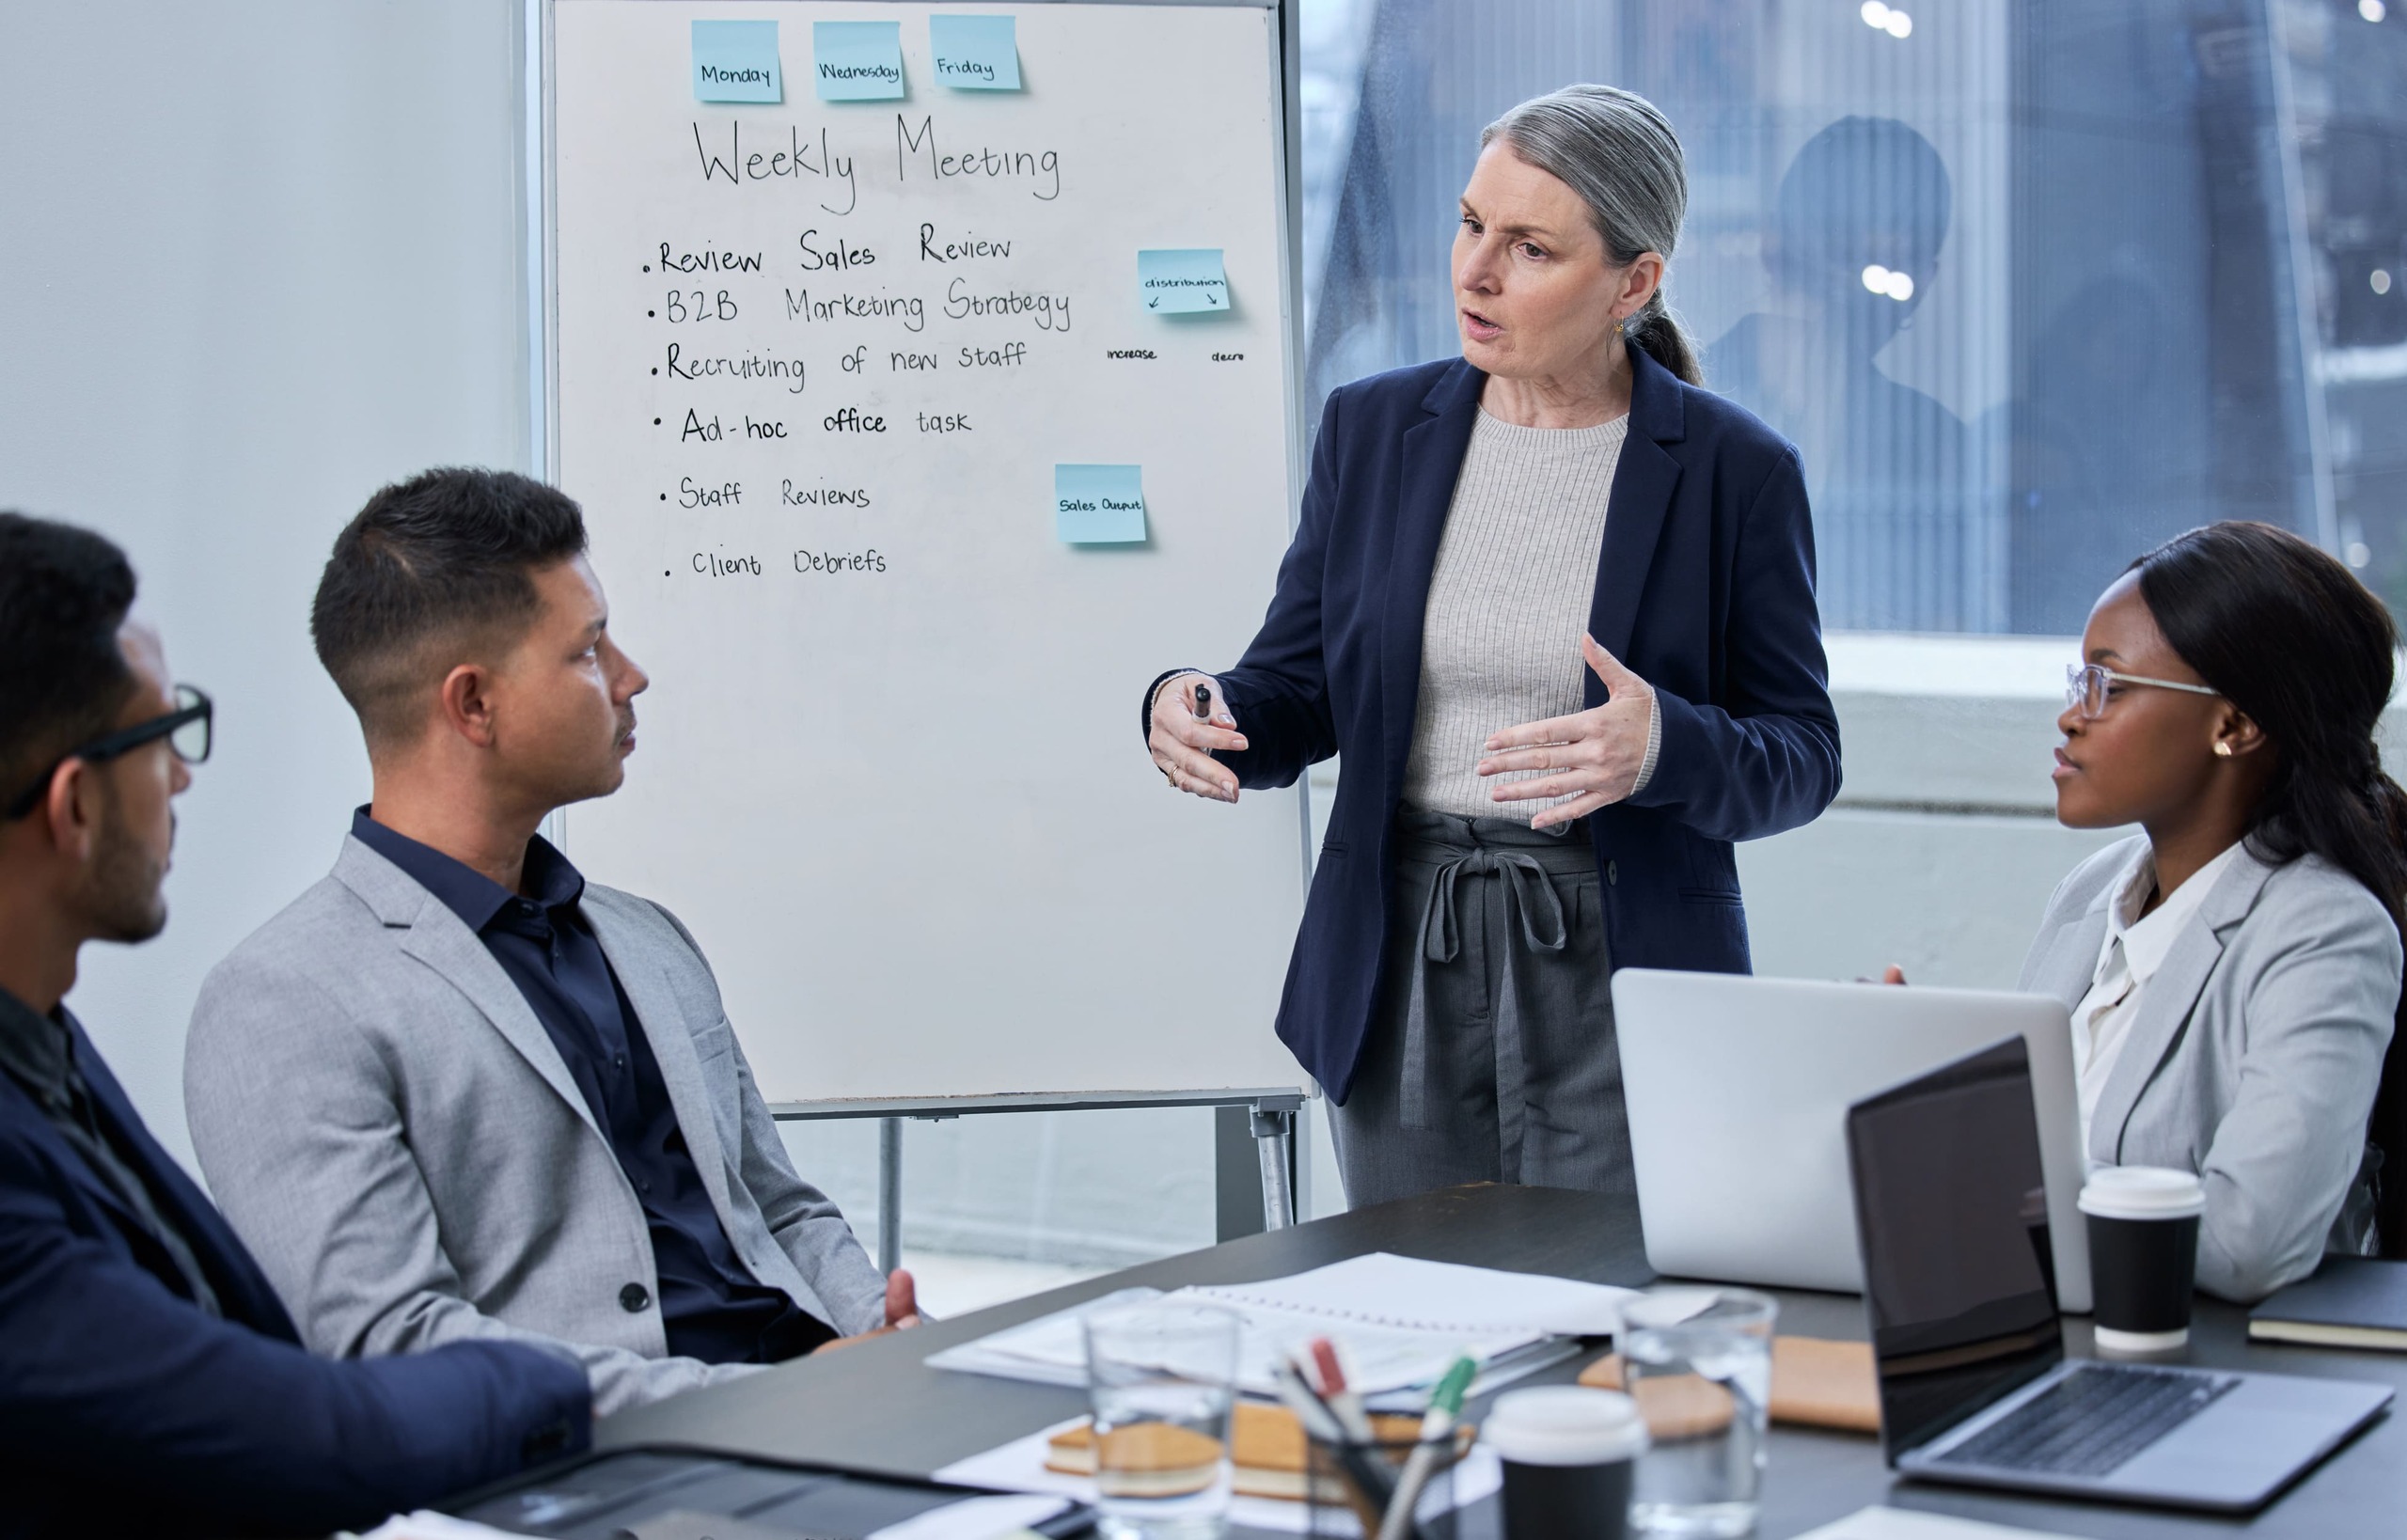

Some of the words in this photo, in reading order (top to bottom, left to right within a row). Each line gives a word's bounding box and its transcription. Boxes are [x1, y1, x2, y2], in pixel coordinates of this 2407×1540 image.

[700, 65, 771, 88] Monday
[819, 63, 901, 84] Wednesday
[936, 58, 995, 82] Friday
[692, 120, 857, 216] Weekly
[897, 113, 1061, 201] Meeting
[659, 240, 763, 274] Review
[799, 228, 876, 272] Sales
[920, 222, 1012, 264] Review
[1144, 276, 1225, 288] distribution
[667, 289, 739, 323] B2B
[784, 286, 925, 333] Marketing
[943, 276, 1072, 333] Strategy
[667, 342, 806, 395] Recruiting
[841, 344, 869, 376] of
[890, 352, 938, 372] new
[1107, 349, 1158, 360] increase
[681, 407, 789, 444] Ad-hoc
[823, 403, 888, 434] office
[915, 410, 973, 435] task
[678, 476, 743, 510] Staff
[781, 477, 872, 509] Reviews
[1059, 498, 1097, 512] Sales
[1101, 497, 1142, 512] Output
[691, 543, 763, 577] Client
[794, 548, 888, 575] Debriefs
